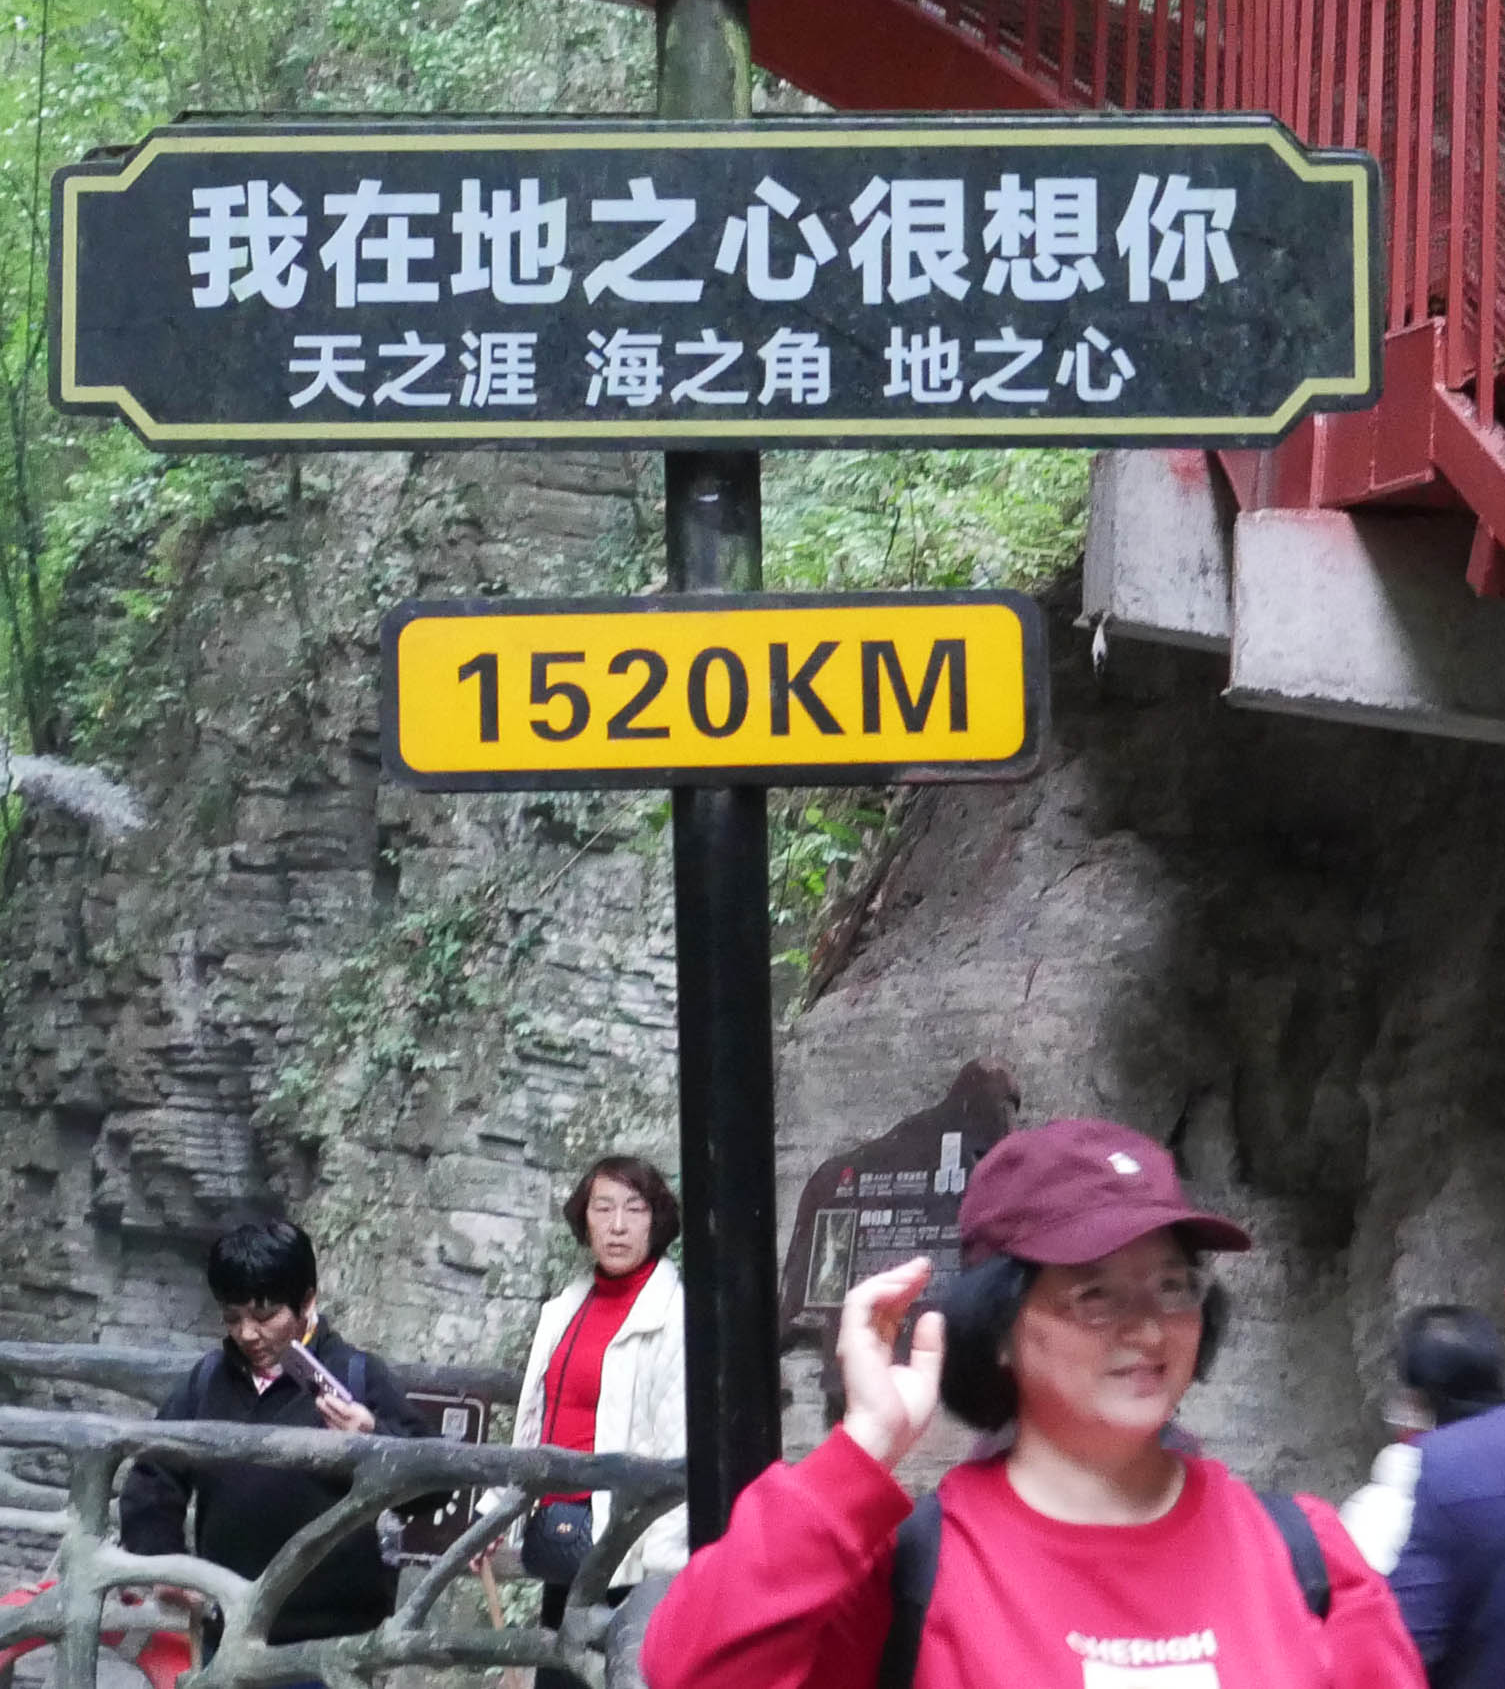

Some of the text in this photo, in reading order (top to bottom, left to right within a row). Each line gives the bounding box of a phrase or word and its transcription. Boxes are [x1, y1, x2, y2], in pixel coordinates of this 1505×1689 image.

[187, 172, 1240, 310] 我在地之心很想你
[288, 324, 1137, 409] 天之涯 海之角 地之心
[457, 638, 969, 743] 1520KM
